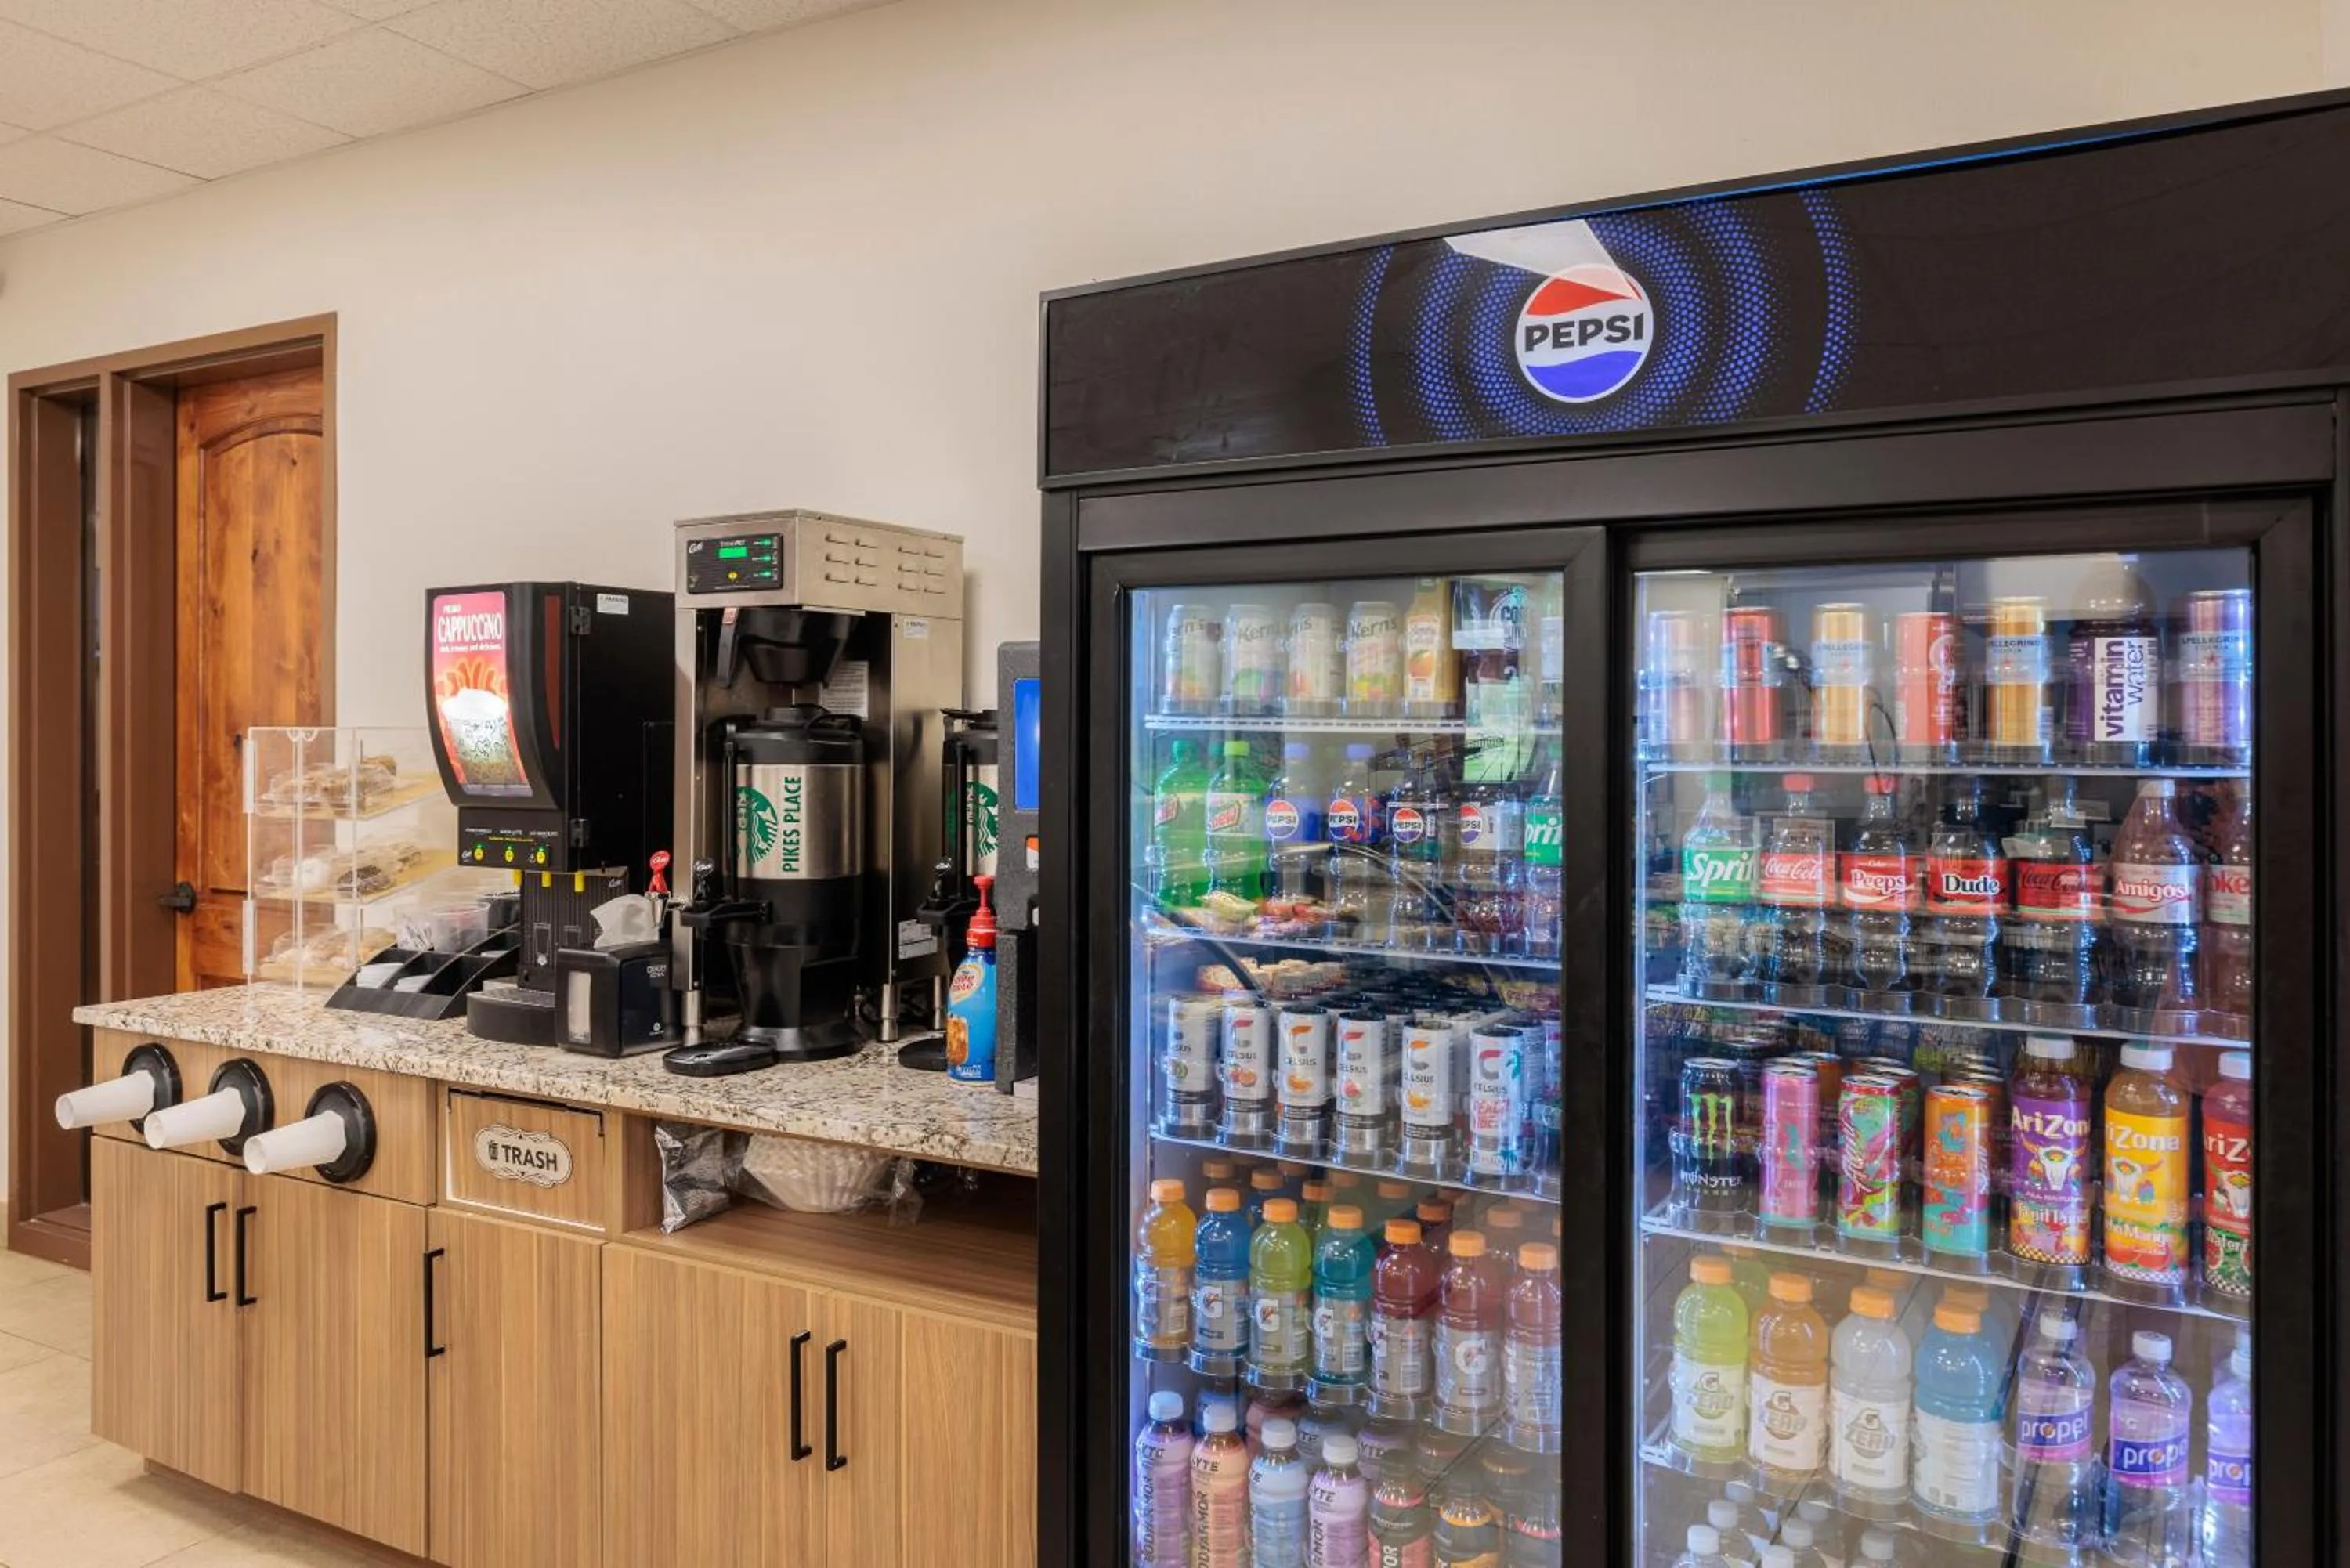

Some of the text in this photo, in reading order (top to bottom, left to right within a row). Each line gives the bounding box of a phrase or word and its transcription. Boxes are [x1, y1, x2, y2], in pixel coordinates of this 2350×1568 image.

[1525, 313, 1644, 352] PEPSI
[2100, 641, 2124, 738] vitamin
[2128, 641, 2144, 705] water
[782, 776, 801, 872] PIKES PLACE
[1851, 869, 1906, 894] Peeps
[1943, 873, 2000, 894] Dude
[2115, 878, 2186, 902] Amigos
[2011, 1105, 2091, 1140] AriZon
[501, 1144, 558, 1172] TRASH
[2020, 1411, 2088, 1443] propel
